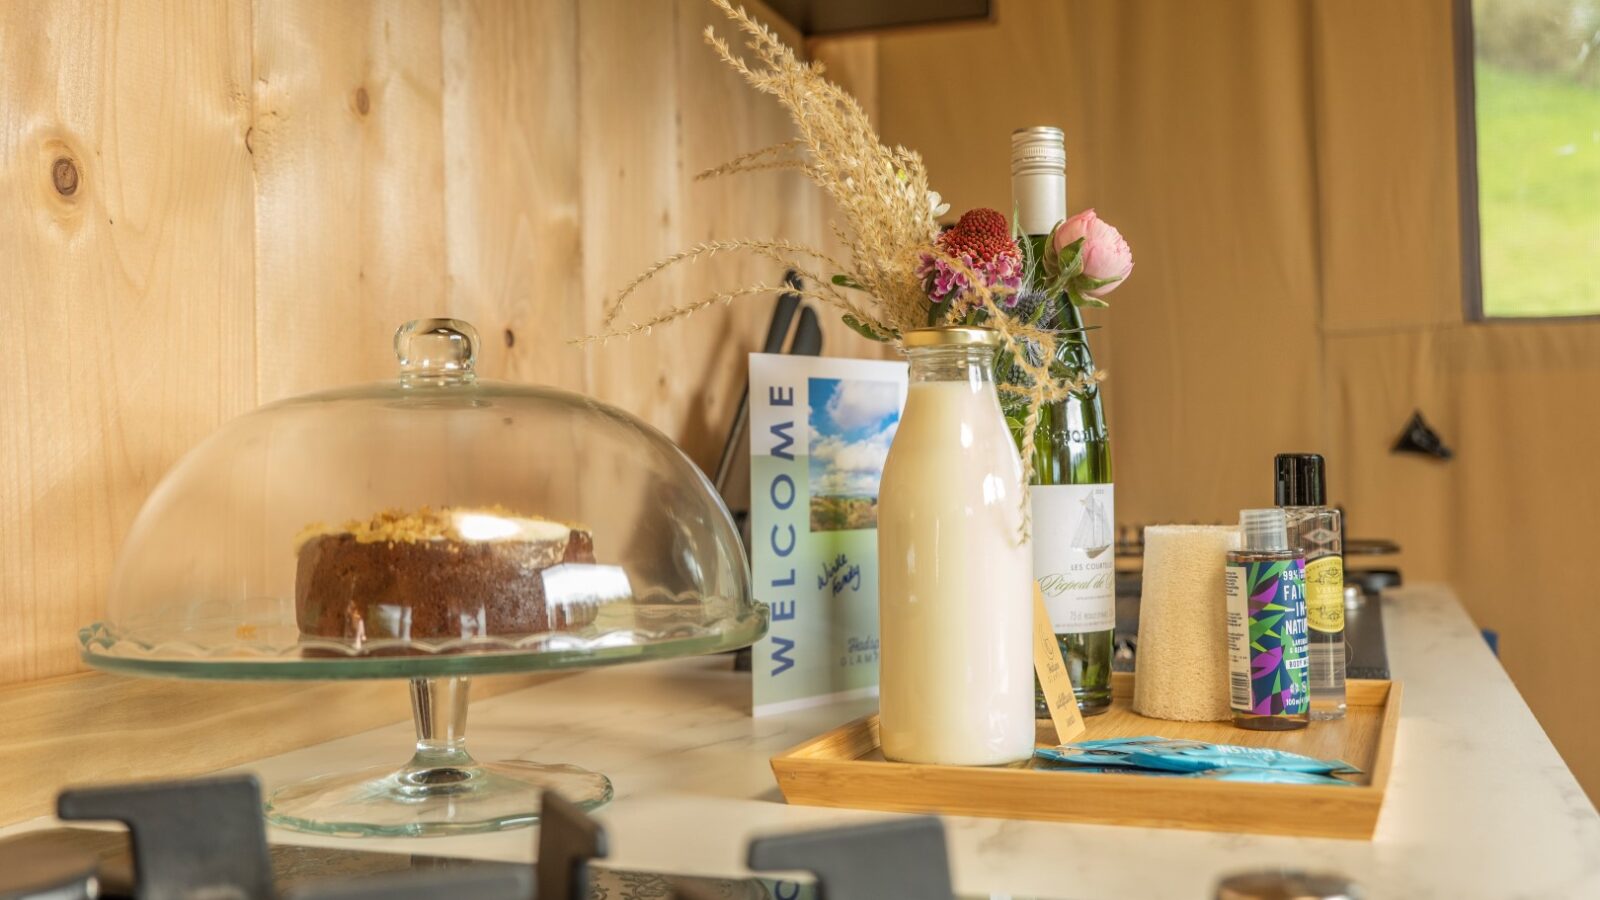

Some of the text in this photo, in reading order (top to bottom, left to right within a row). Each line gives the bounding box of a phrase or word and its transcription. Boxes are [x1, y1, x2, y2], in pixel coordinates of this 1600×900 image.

[769, 386, 796, 677] WELCOME
[1283, 569, 1298, 581] 99%
[1283, 583, 1306, 601] FAIT
[1285, 617, 1308, 636] NATU
